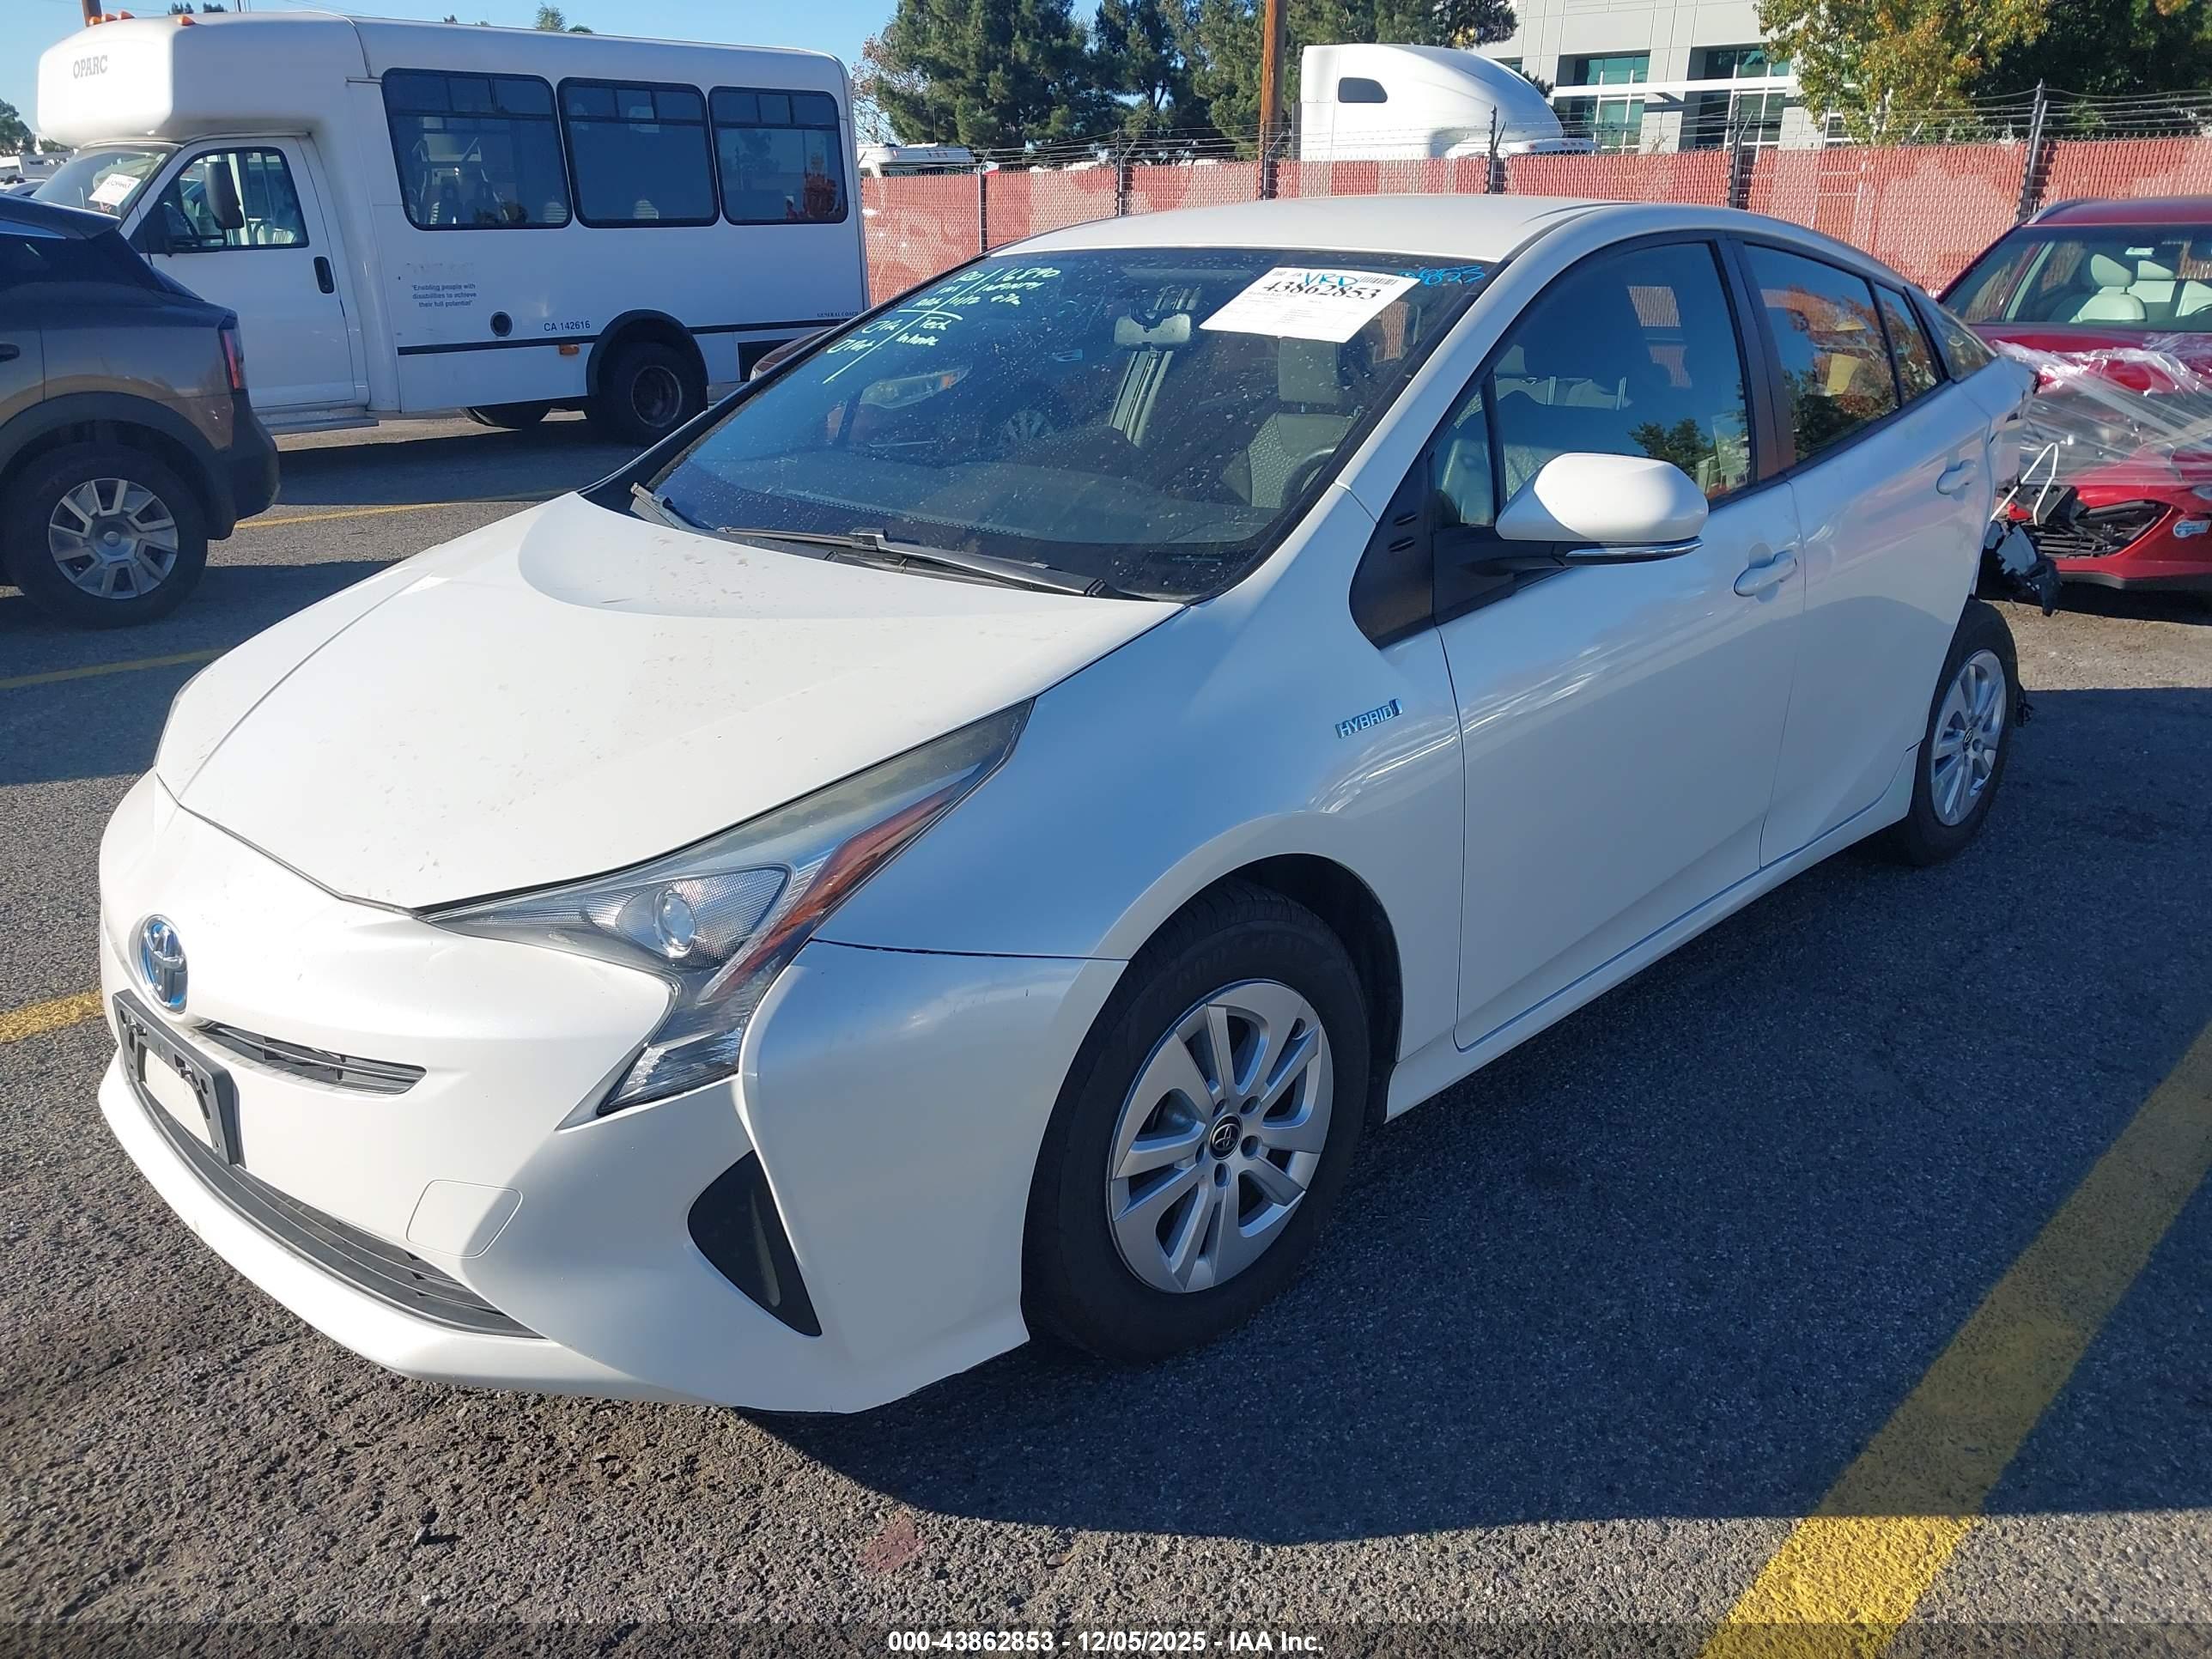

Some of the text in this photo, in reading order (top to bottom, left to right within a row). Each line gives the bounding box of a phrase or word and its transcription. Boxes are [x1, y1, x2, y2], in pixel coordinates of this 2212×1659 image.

[72, 54, 108, 79] OPARC
[1264, 281, 1382, 300] 43862853
[544, 319, 591, 331] CA 142616
[1336, 704, 1395, 738] HYBRID
